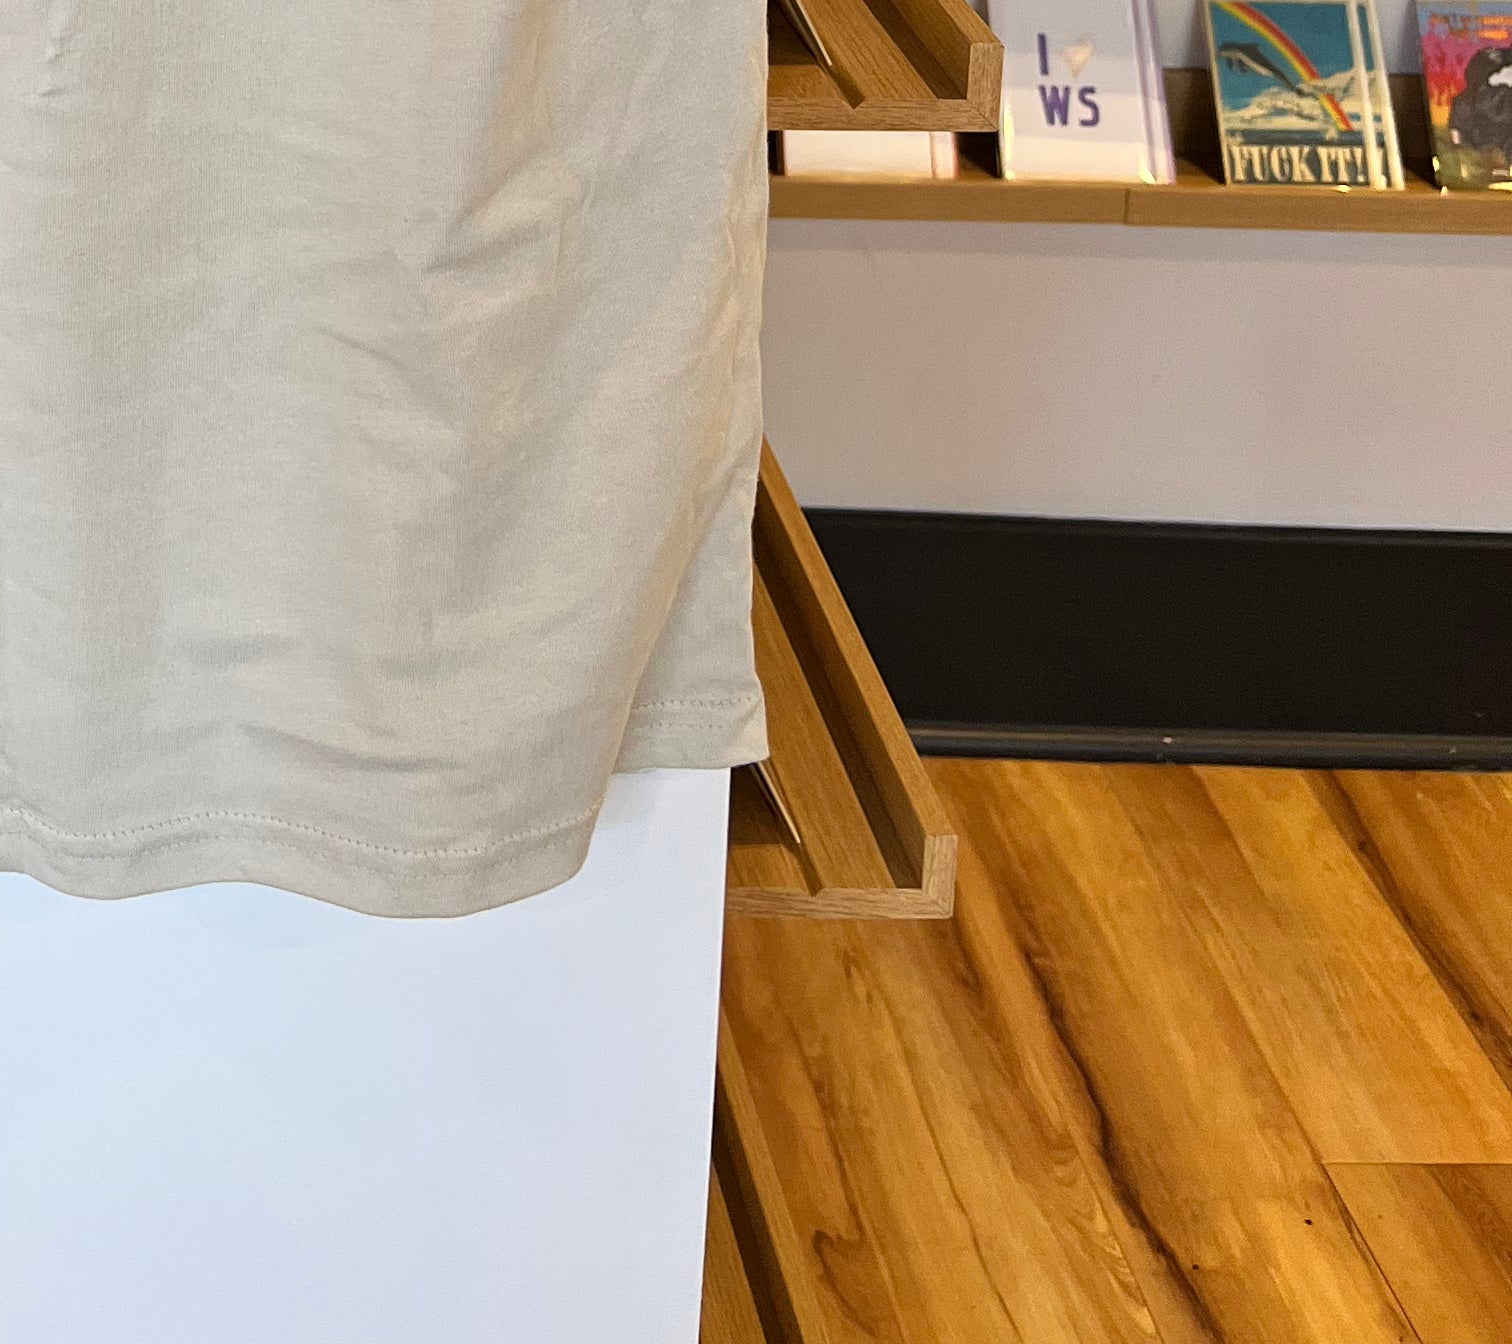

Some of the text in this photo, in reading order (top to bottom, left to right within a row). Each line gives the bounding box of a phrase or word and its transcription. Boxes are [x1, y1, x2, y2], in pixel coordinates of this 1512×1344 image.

[1037, 32, 1049, 76] I
[1038, 84, 1101, 127] WS
[1230, 144, 1366, 183] FUCK IT!
